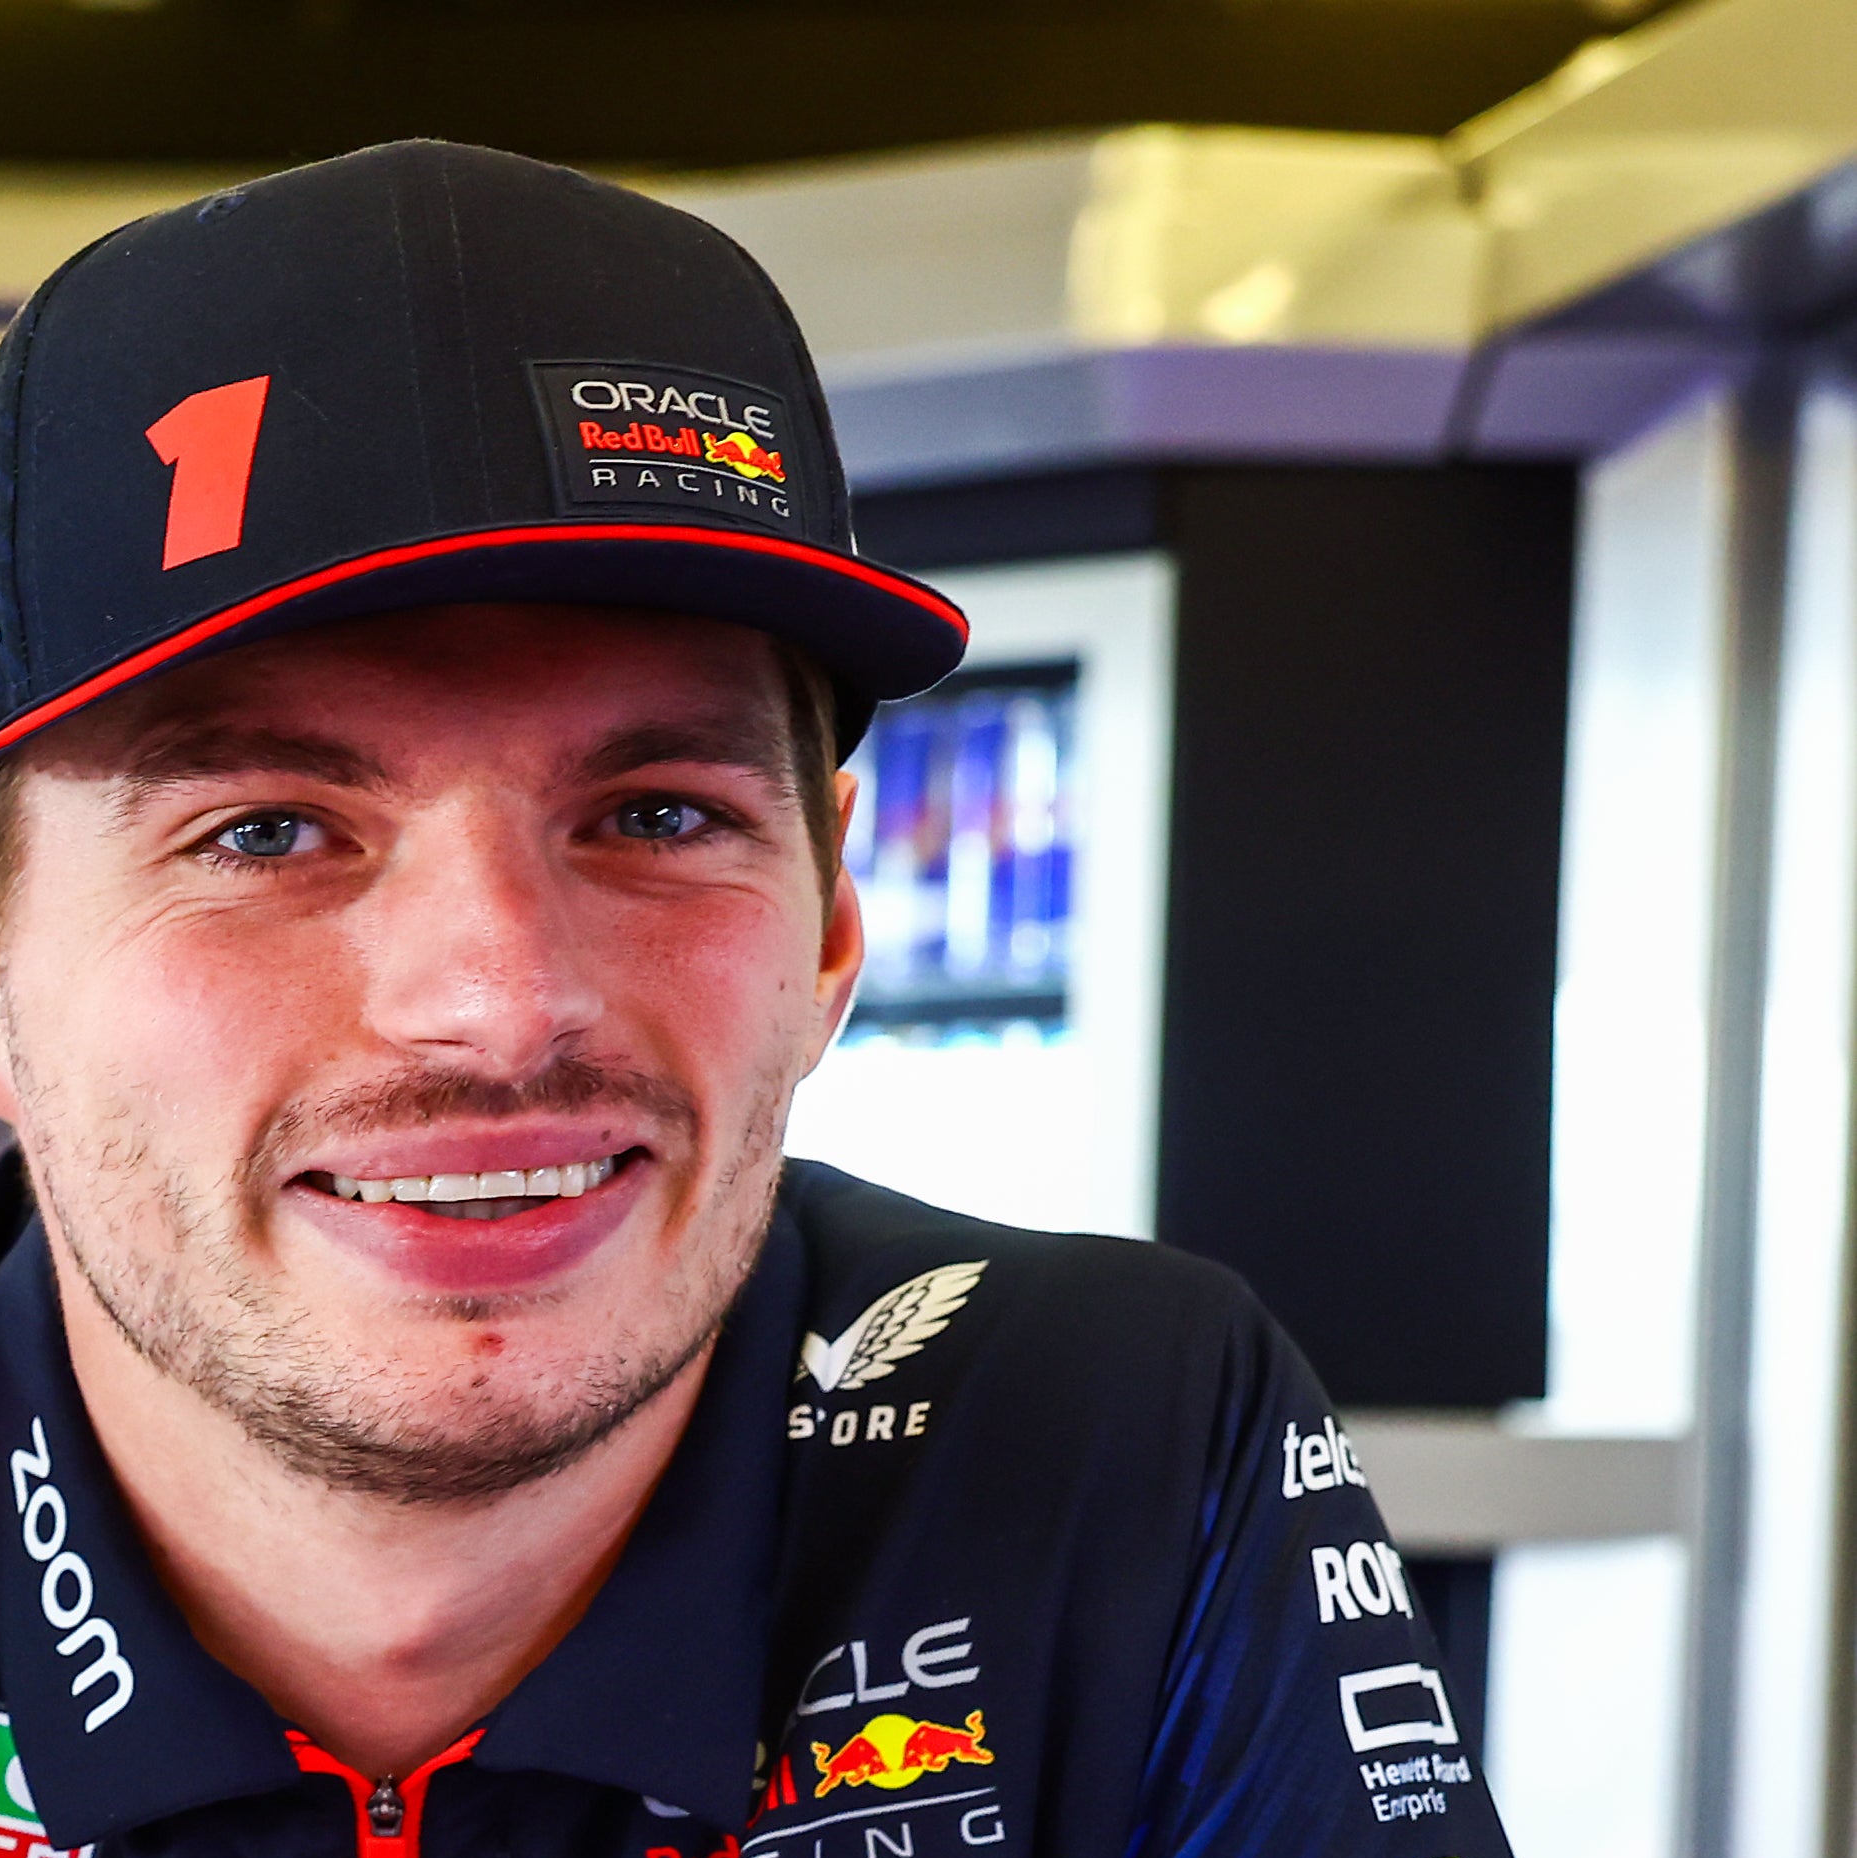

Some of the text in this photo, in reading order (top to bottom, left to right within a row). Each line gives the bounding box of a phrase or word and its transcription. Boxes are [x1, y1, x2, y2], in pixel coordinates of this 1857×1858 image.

[144, 375, 270, 570] 1
[571, 380, 775, 440] ORACLE
[590, 467, 791, 518] RACING
[9, 1415, 135, 1735] zoom
